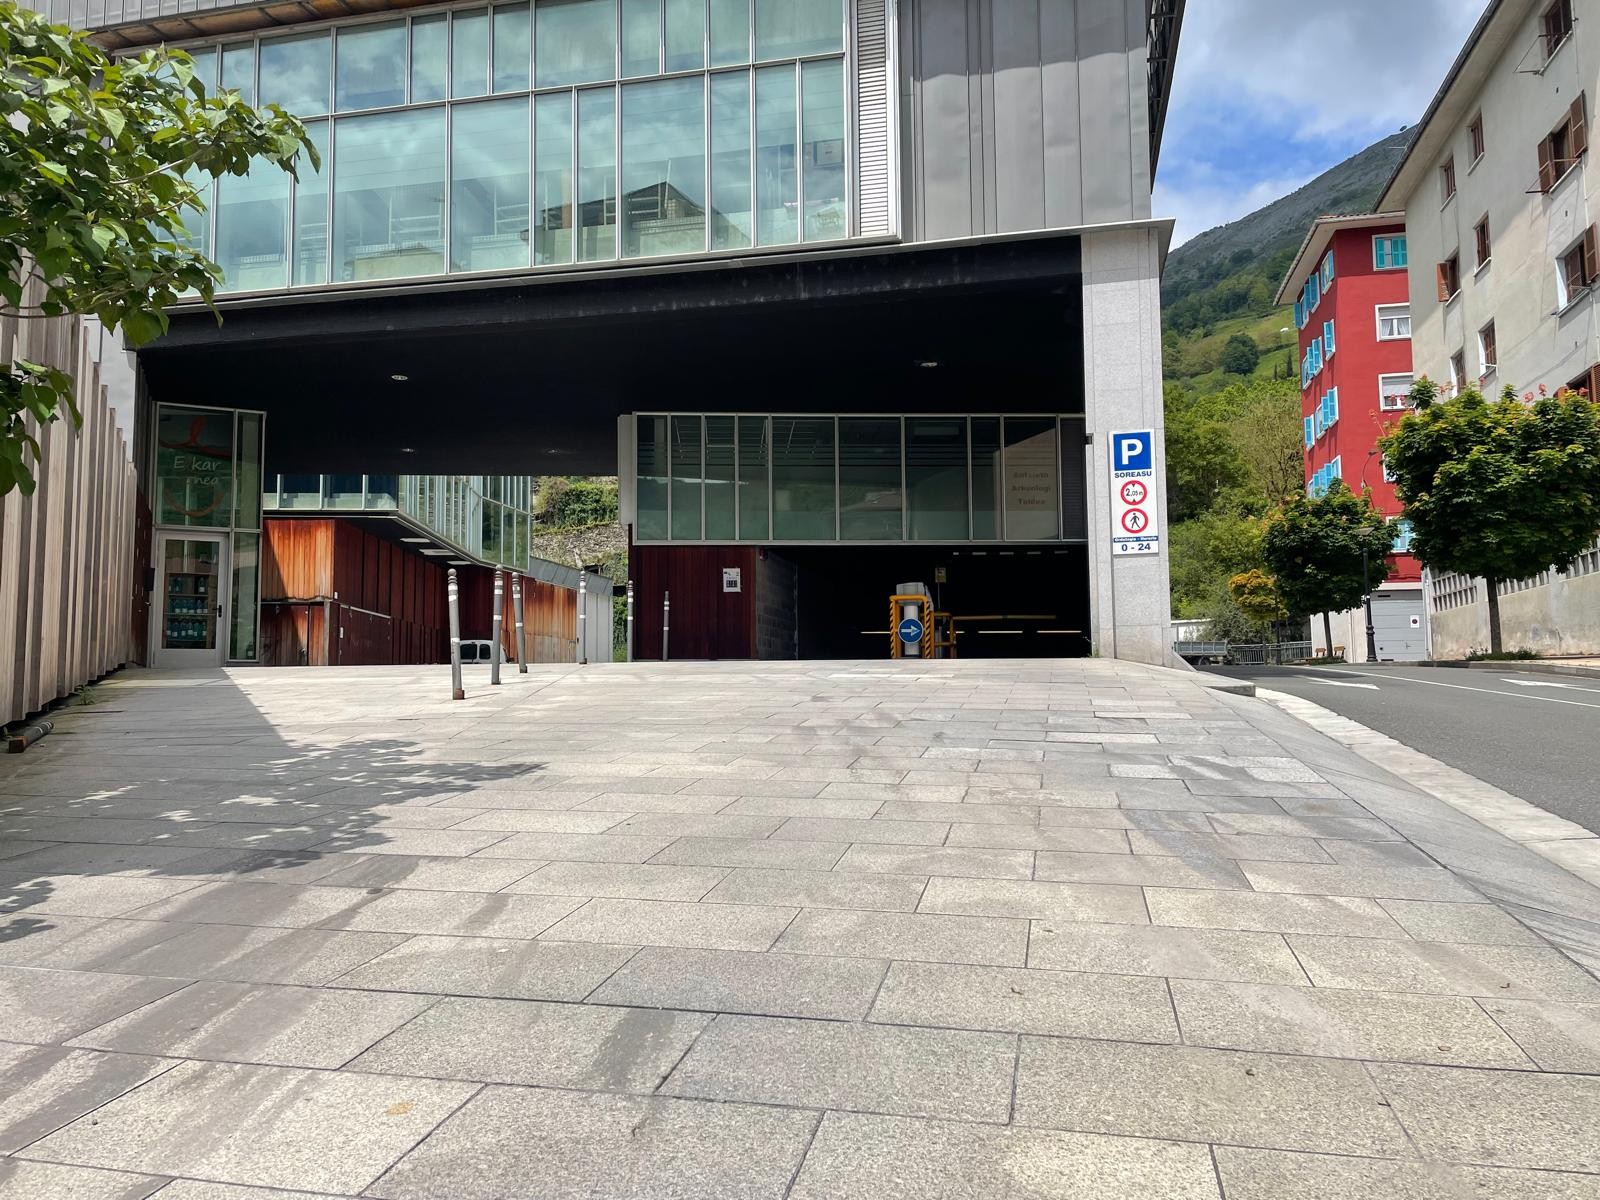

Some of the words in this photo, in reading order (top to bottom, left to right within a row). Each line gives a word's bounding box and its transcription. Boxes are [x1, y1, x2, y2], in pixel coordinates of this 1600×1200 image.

[1121, 439, 1143, 465] P
[1114, 470, 1152, 478] SOREASU
[1121, 543, 1128, 552] 0
[1138, 543, 1151, 551] 24
